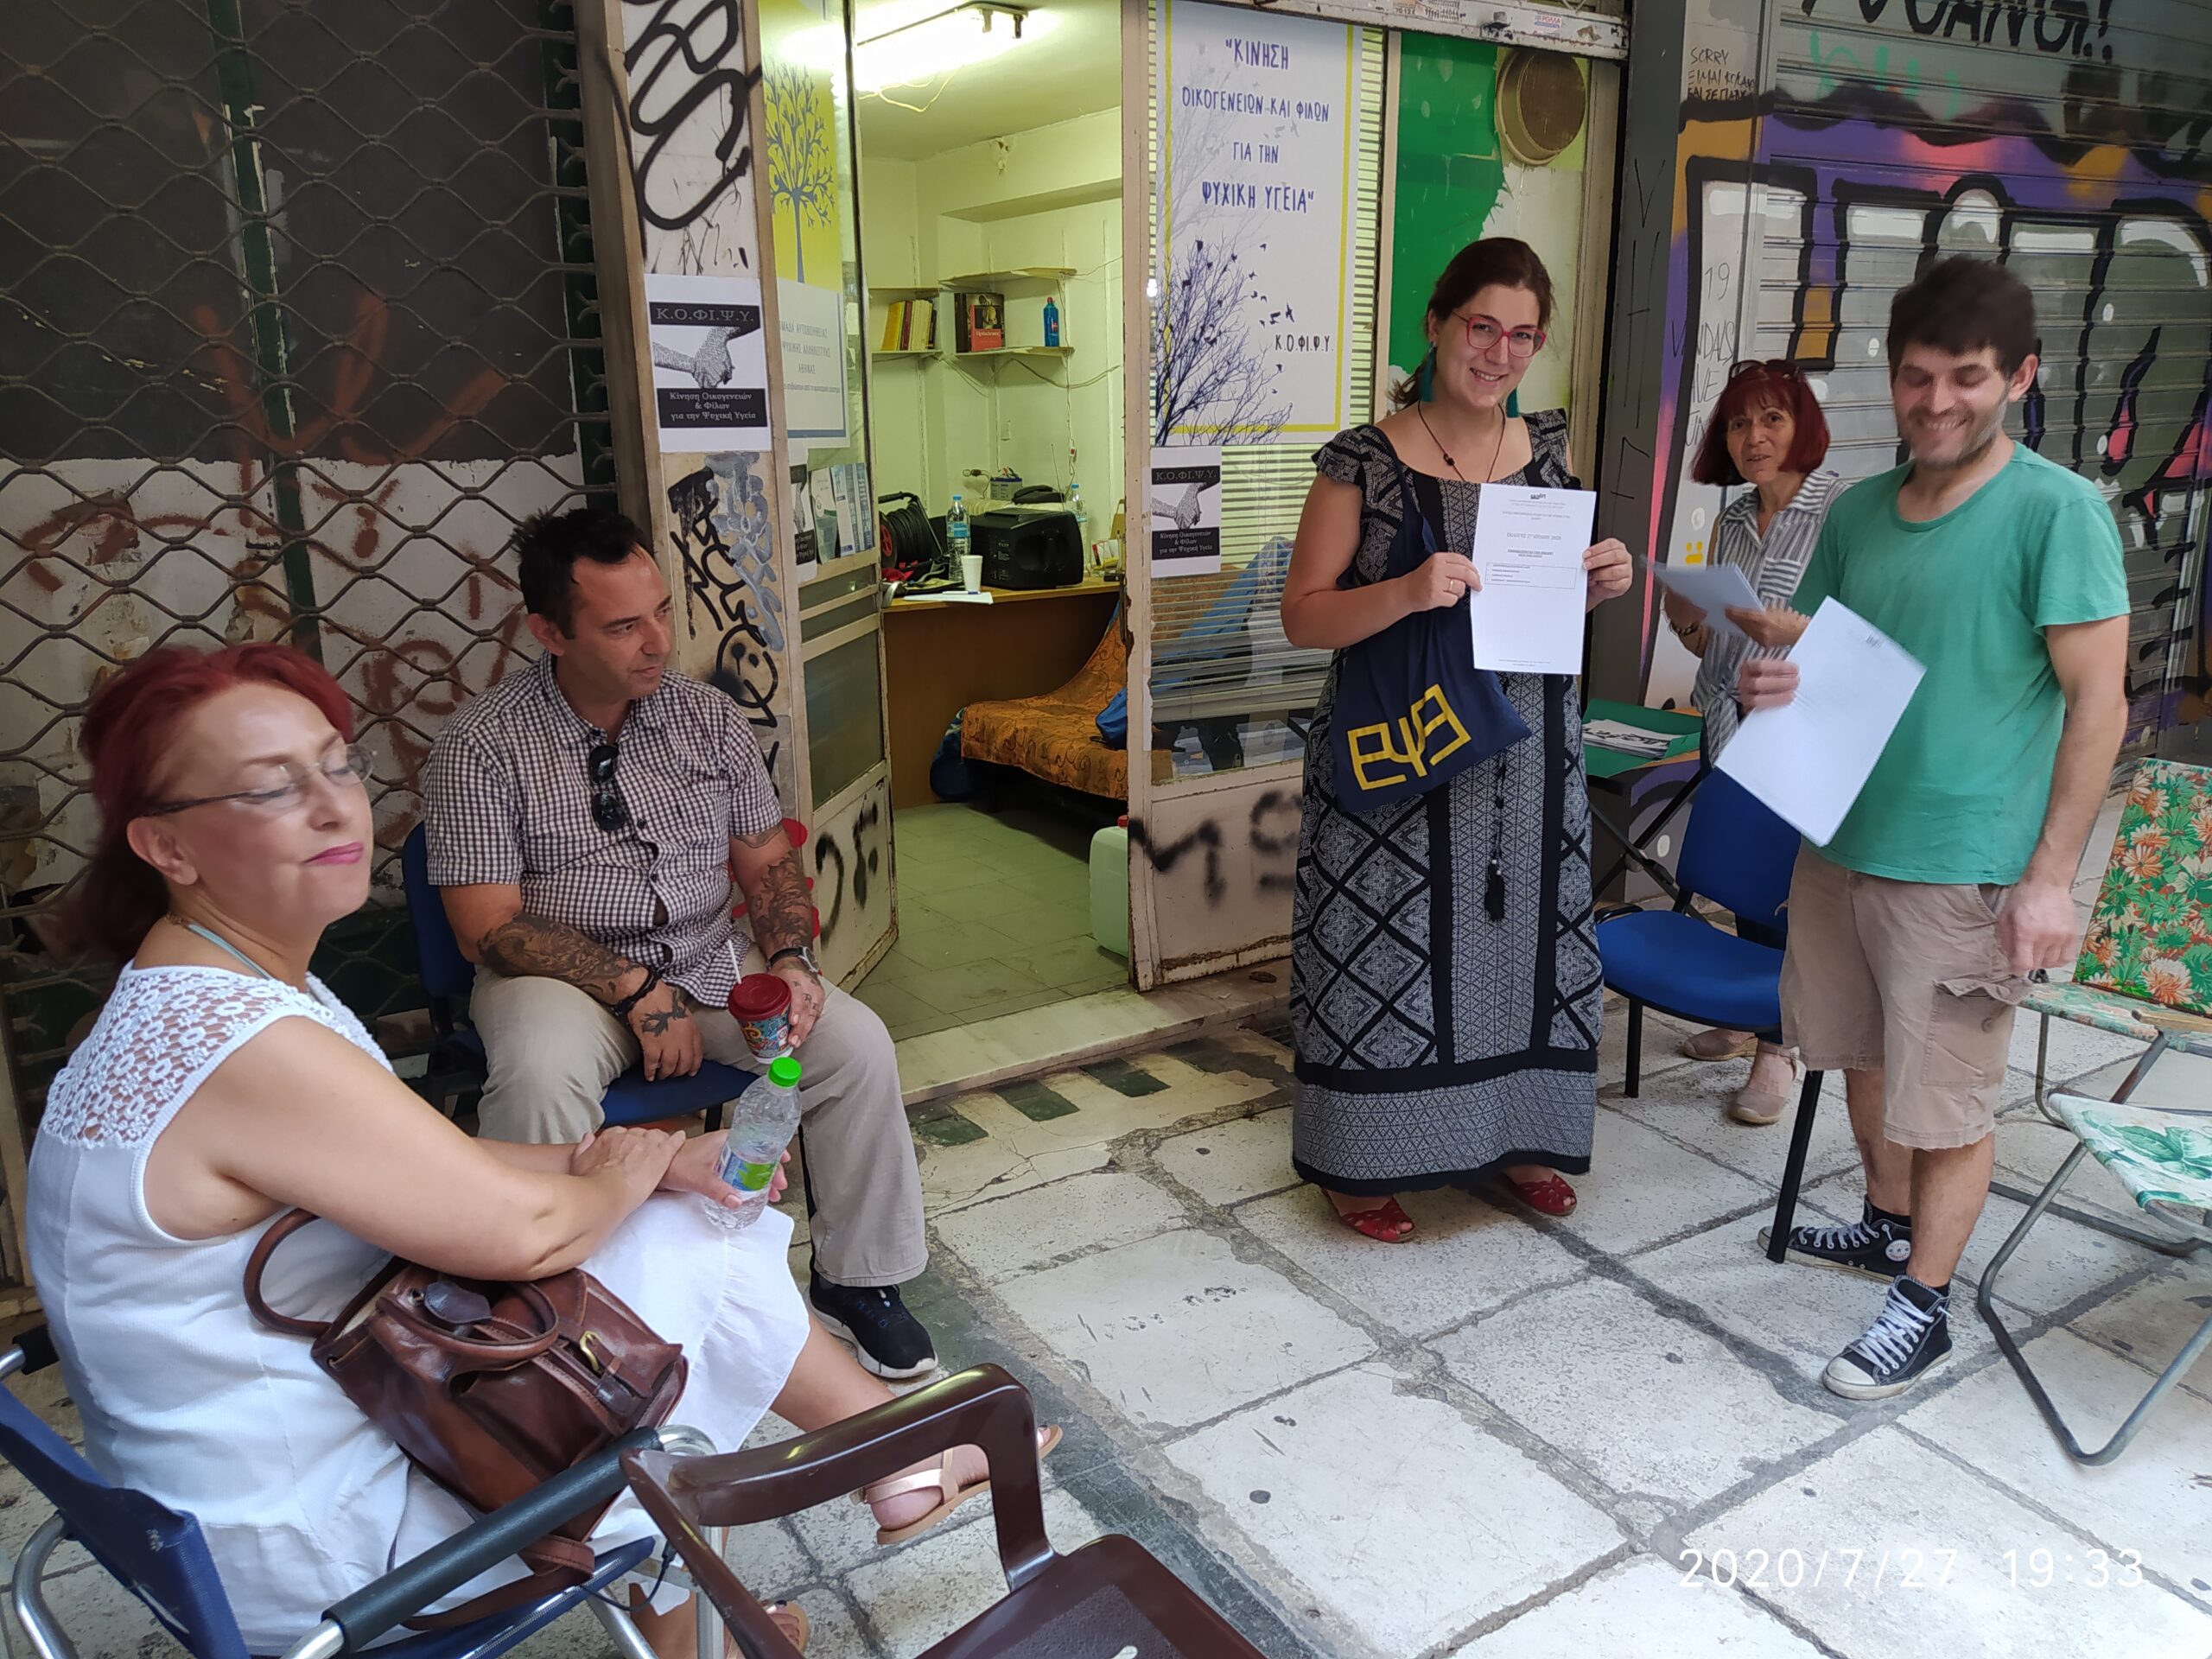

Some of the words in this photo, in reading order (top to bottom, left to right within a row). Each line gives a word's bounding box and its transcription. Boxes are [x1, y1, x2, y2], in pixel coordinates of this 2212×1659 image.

[1225, 38, 1289, 70] "ΚΙΝΗΣΗ
[1182, 86, 1264, 115] ΟΙΚΟΓΕΝΕΙΩΝ
[1270, 98, 1290, 118] ΚΑΙ
[1296, 101, 1330, 122] ΦΙΛΩΝ
[1233, 142, 1252, 162] ΓΙΑ
[1259, 144, 1279, 163] ΤΗΝ
[1202, 181, 1255, 208] ΨΥΧΙΚΗ
[1265, 186, 1314, 213] ΥΓΕΙΑ"
[1704, 262, 1730, 301] 19
[656, 308, 754, 322] Κ.Ο.ΦΙ.Ψ.Υ.
[1275, 334, 1334, 353] Κ.Ο.ΦΙ.Ψ.Υ.
[1671, 320, 1735, 366] VNDALS
[670, 391, 700, 402] Κίνηση
[702, 391, 753, 402] Οικογενειών
[671, 413, 684, 422] για
[702, 411, 733, 422] Ψυχική
[734, 410, 756, 421] Υγεία
[1155, 469, 1217, 481] Κ.Ο.ΦΙ.Ψ.Υ.
